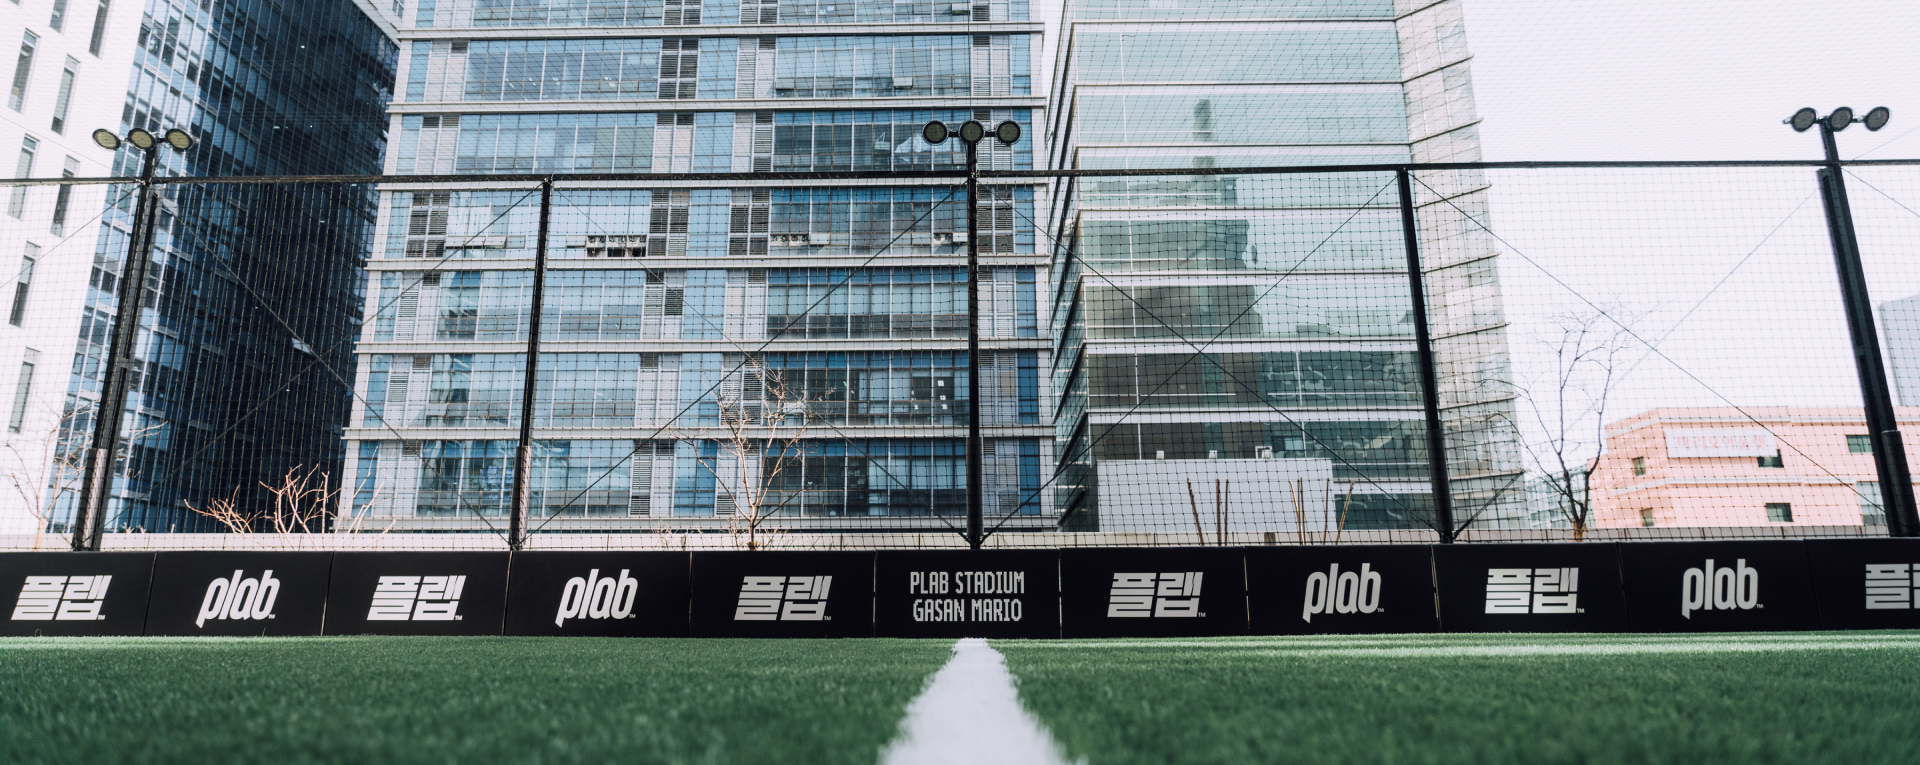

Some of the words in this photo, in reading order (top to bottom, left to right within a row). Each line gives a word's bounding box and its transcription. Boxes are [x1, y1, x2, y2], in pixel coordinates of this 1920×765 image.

[910, 571, 949, 594] PLAB
[955, 571, 1025, 594] STADIUM
[1865, 563, 1920, 610] 플
[913, 599, 965, 622] GASAN
[971, 598, 1022, 622] MARIO
